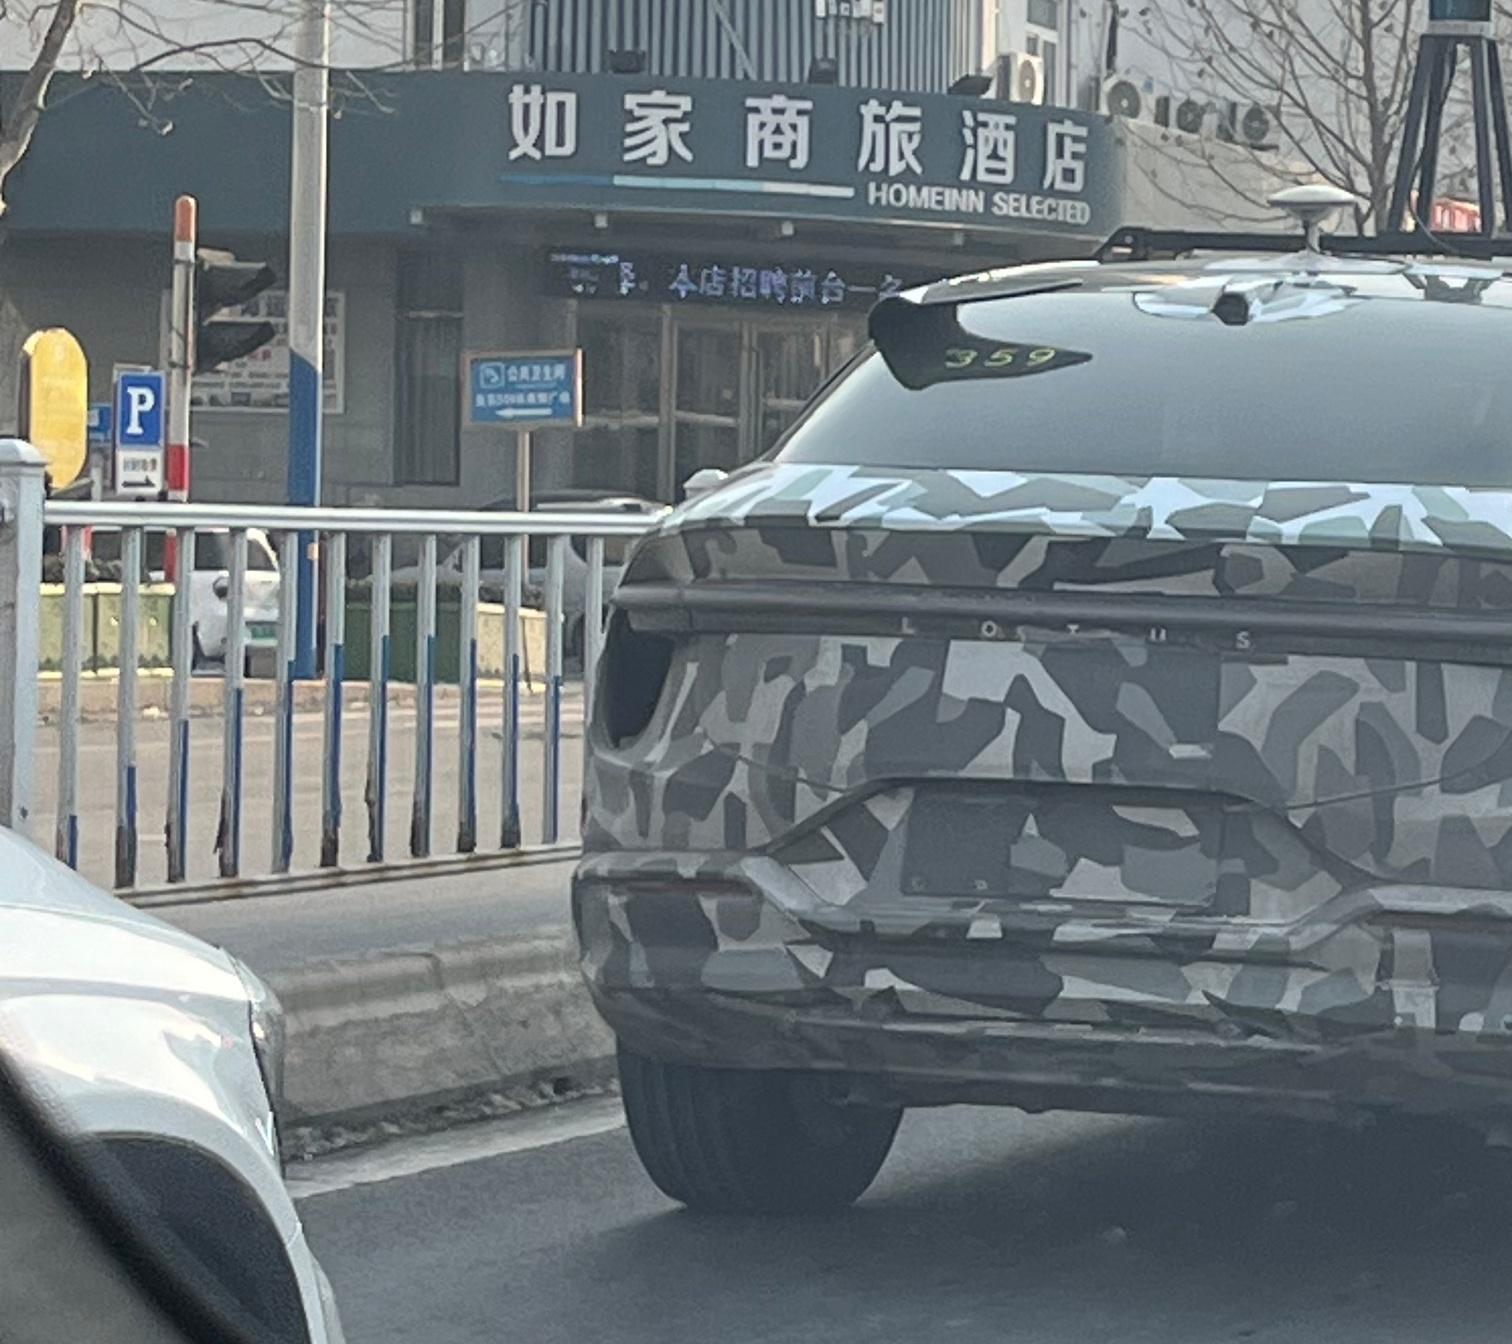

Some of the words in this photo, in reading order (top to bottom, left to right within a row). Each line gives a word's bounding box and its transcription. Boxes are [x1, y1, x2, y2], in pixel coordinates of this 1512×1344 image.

[507, 83, 1090, 193] 如家商旅酒店
[868, 182, 986, 214] HOMEINN
[991, 191, 1091, 225] SELECTED
[944, 347, 1057, 368] 359
[125, 385, 155, 435] P
